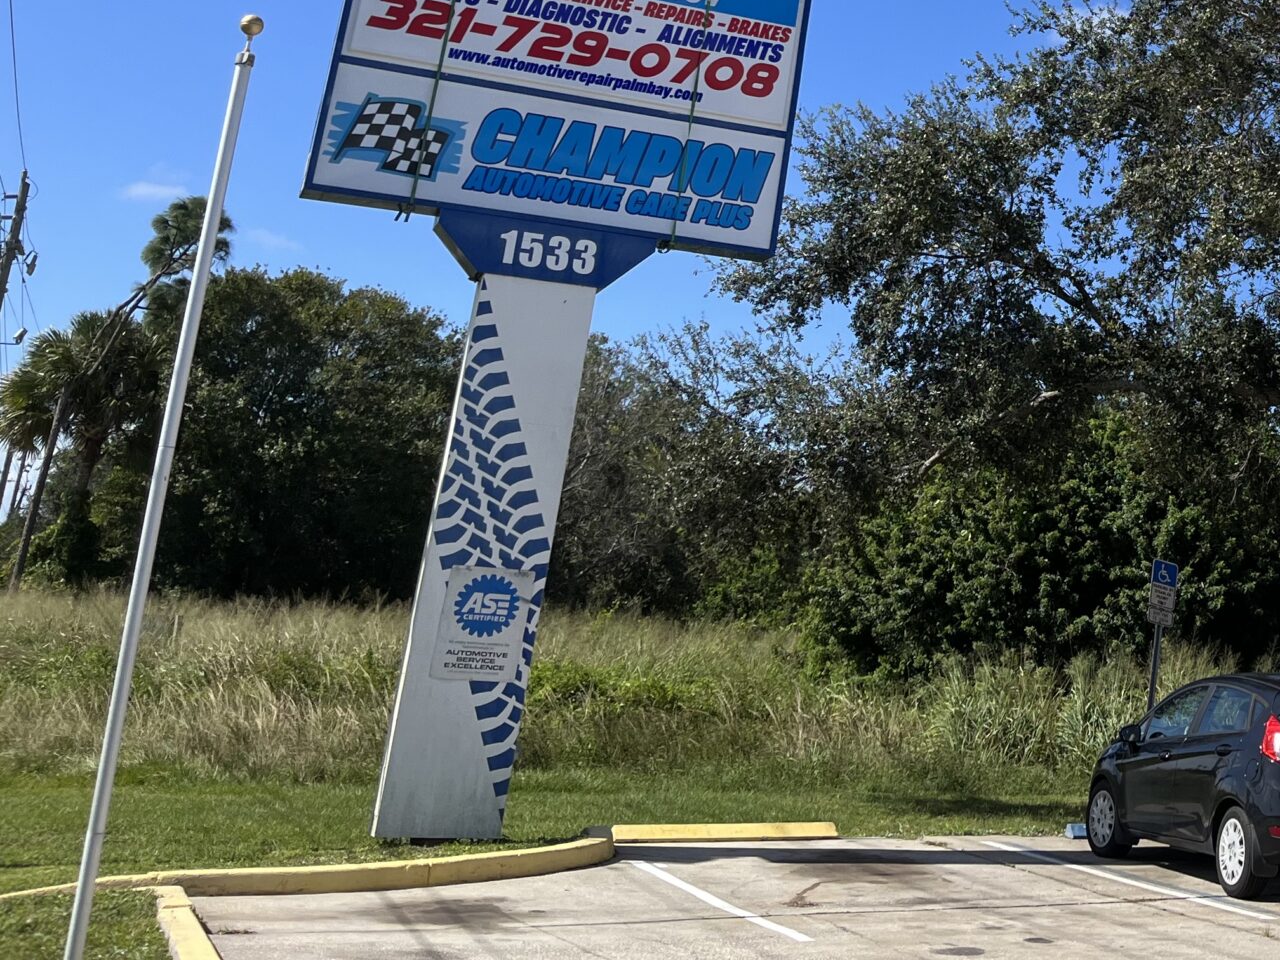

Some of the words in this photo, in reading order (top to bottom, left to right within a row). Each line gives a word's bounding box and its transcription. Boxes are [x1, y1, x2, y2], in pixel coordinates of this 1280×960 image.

[643, 1, 715, 29] REPAIRS
[727, 18, 792, 43] BRAKES
[656, 24, 784, 63] ALIGNMENTS
[448, 47, 703, 102] www.automotiverepairpalmbay.com
[471, 107, 776, 204] CHAMPION
[462, 165, 627, 211] AUTOMOTIVE
[625, 189, 692, 222] CARE
[690, 199, 754, 230] PLUS
[500, 229, 597, 275] 1533
[461, 592, 511, 615] ASE
[463, 613, 506, 622] CERTIFIED
[443, 662, 505, 671] EXCELLENCE
[446, 649, 508, 658] AUTOMOTIVE
[456, 656, 496, 664] SERVICE
